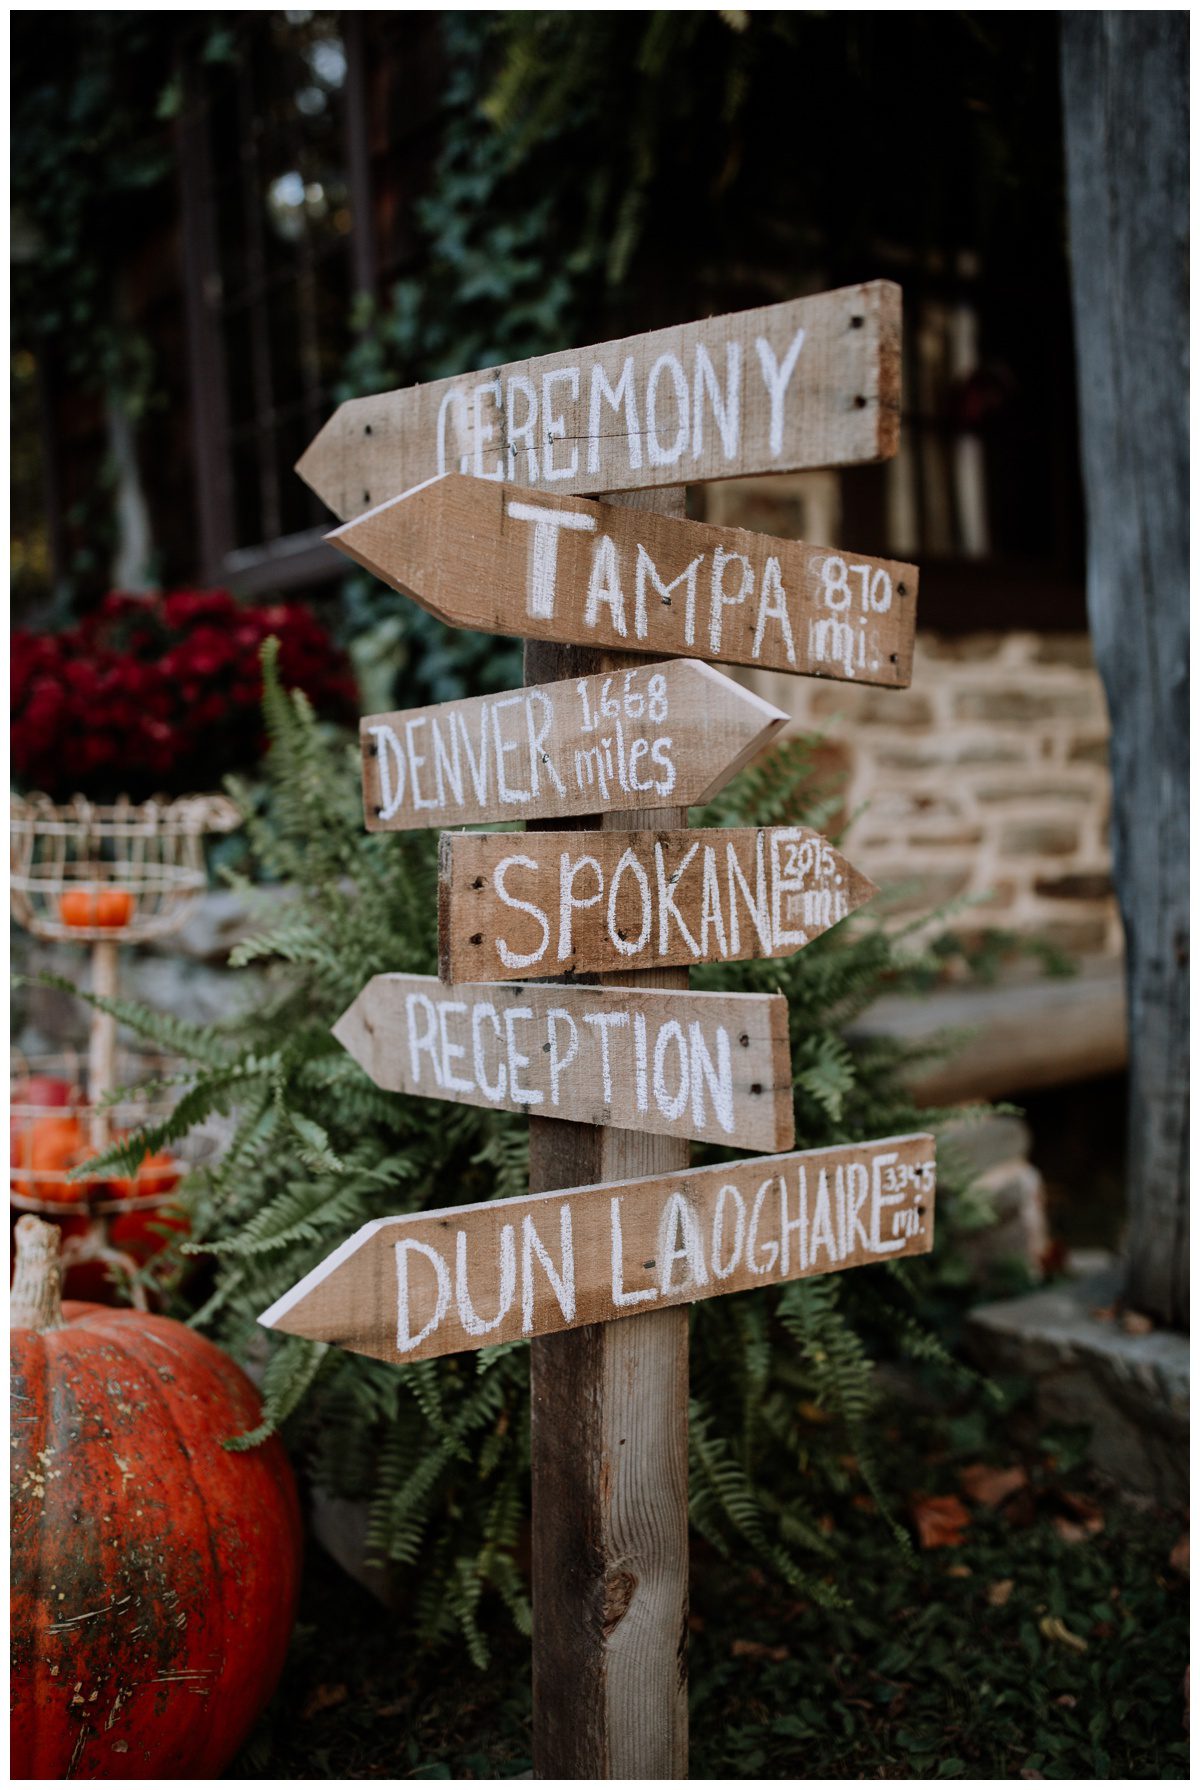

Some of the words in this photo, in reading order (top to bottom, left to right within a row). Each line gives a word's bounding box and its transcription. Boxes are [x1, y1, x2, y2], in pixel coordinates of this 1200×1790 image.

[437, 330, 804, 482] CEREMONY
[506, 502, 797, 665] TAMPA
[821, 556, 893, 613] 870
[368, 690, 566, 820] DENVER
[574, 719, 677, 800] miles
[495, 826, 808, 969] SPOKANE
[406, 993, 735, 1134] RECEPTION
[395, 1203, 576, 1353] DUN
[611, 1153, 906, 1306] LAOGHAIRE
